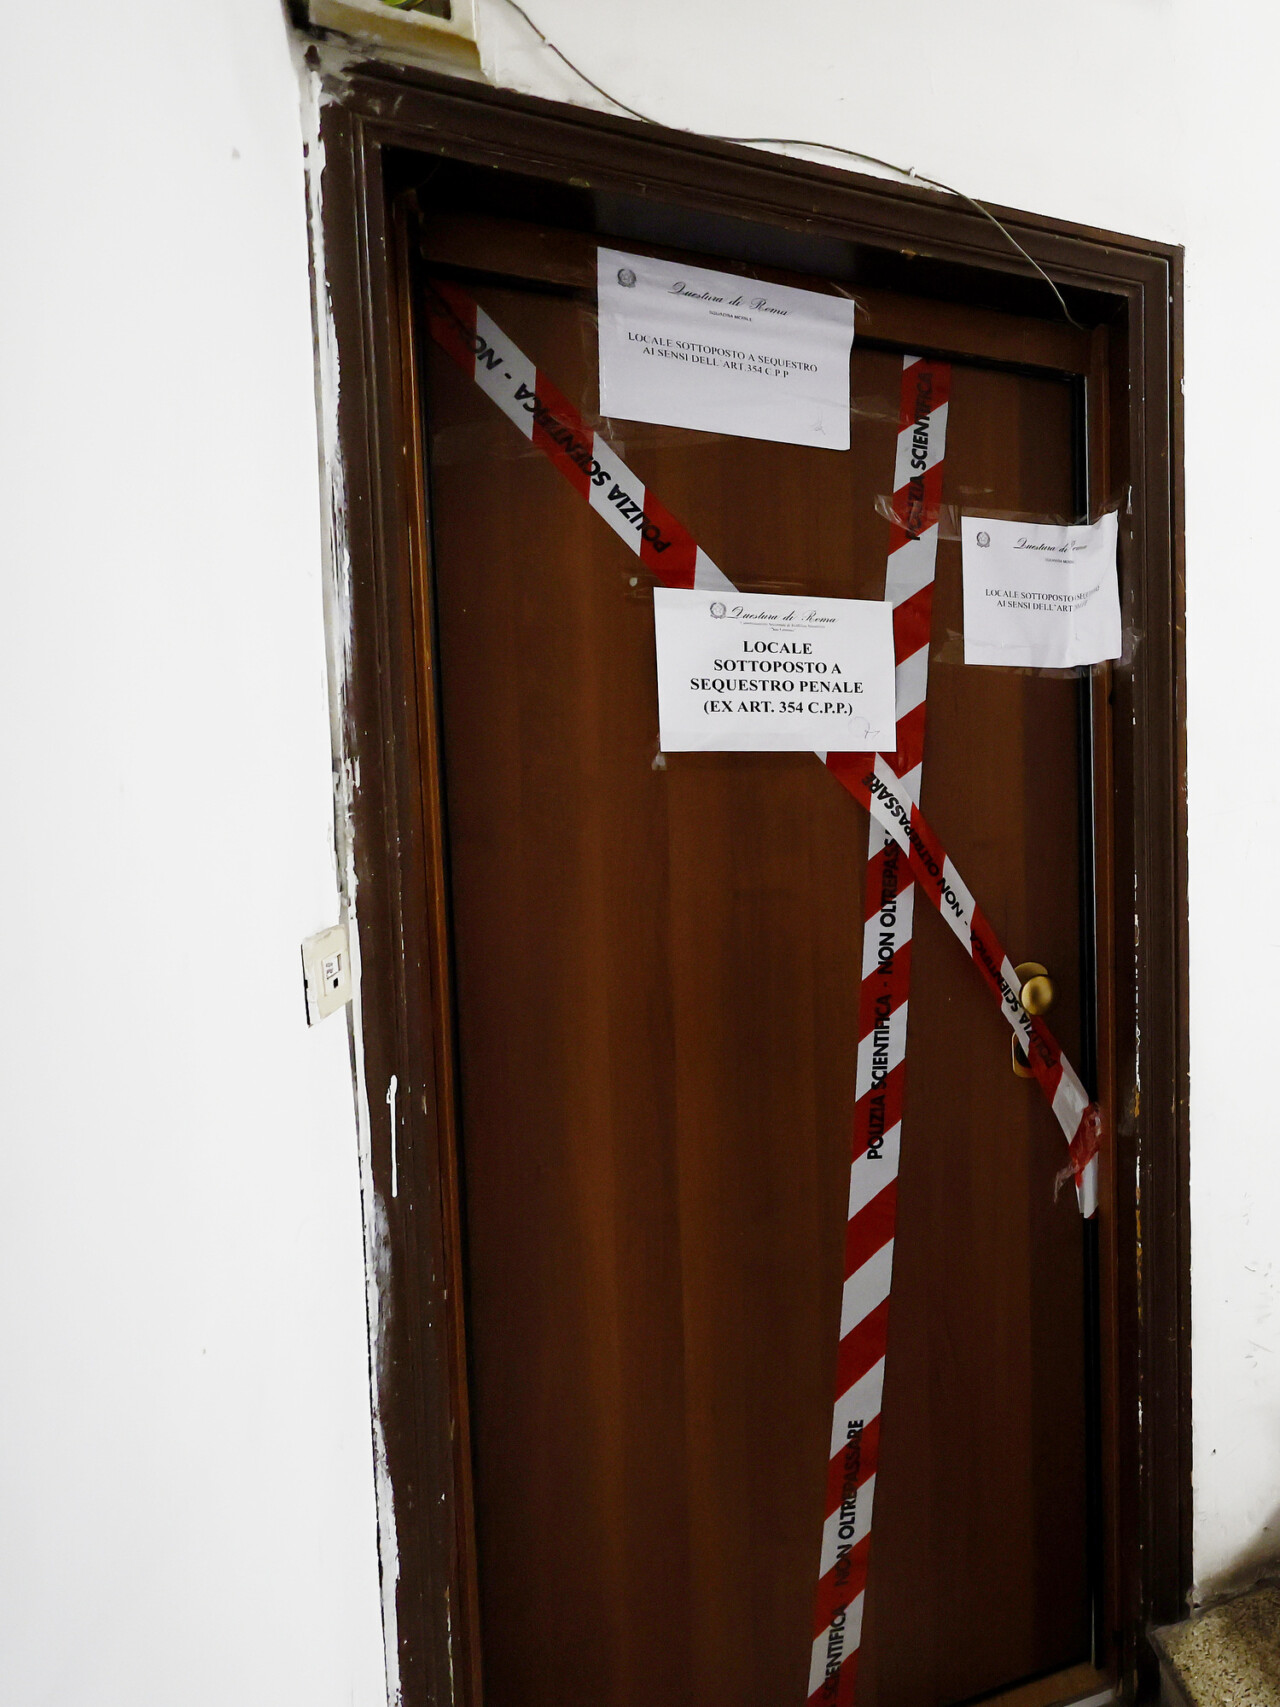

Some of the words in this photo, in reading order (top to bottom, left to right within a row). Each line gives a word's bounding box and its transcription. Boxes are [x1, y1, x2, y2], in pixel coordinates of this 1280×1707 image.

[668, 282, 723, 303] Questura
[728, 296, 742, 307] di
[750, 298, 789, 316] Roma
[628, 332, 673, 347] LOCALE
[676, 340, 746, 361] SOTTOPOSTO
[748, 353, 755, 362] A
[758, 355, 818, 373] SEQUESTRO
[643, 347, 655, 356] AI
[657, 349, 688, 362] SENSI
[513, 383, 612, 487] SCIENTIFICA
[911, 372, 933, 471] SCIENTIFICA
[608, 484, 672, 554] POLIZIA
[1013, 537, 1056, 551] Questura
[1058, 543, 1069, 553] di
[727, 606, 778, 620] Questura
[782, 610, 796, 621] di
[802, 610, 837, 623] Roma
[985, 588, 1019, 598] LOCALE
[1021, 592, 1074, 602] SOTTOPOSTO
[1007, 601, 1031, 609] SENSI
[713, 659, 827, 675] SOTTOPOSTO
[831, 664, 842, 674] A
[743, 640, 813, 655] LOCALE
[690, 678, 795, 694] SEQUESTRO
[799, 681, 864, 694] PENALE
[703, 700, 733, 715] (EX
[737, 701, 774, 714] ART.
[779, 701, 804, 714] 354
[808, 701, 853, 716] C.P.P.)
[863, 772, 940, 877] OLTREPASSARE
[880, 829, 899, 928] OLTREPASS
[937, 877, 964, 918] NON
[878, 932, 895, 975] NON
[871, 994, 893, 1091] SCIENTIFICA
[867, 1094, 886, 1160] POLIZIA
[838, 1419, 864, 1539] OLTREPASSARE
[835, 1542, 853, 1587] NON
